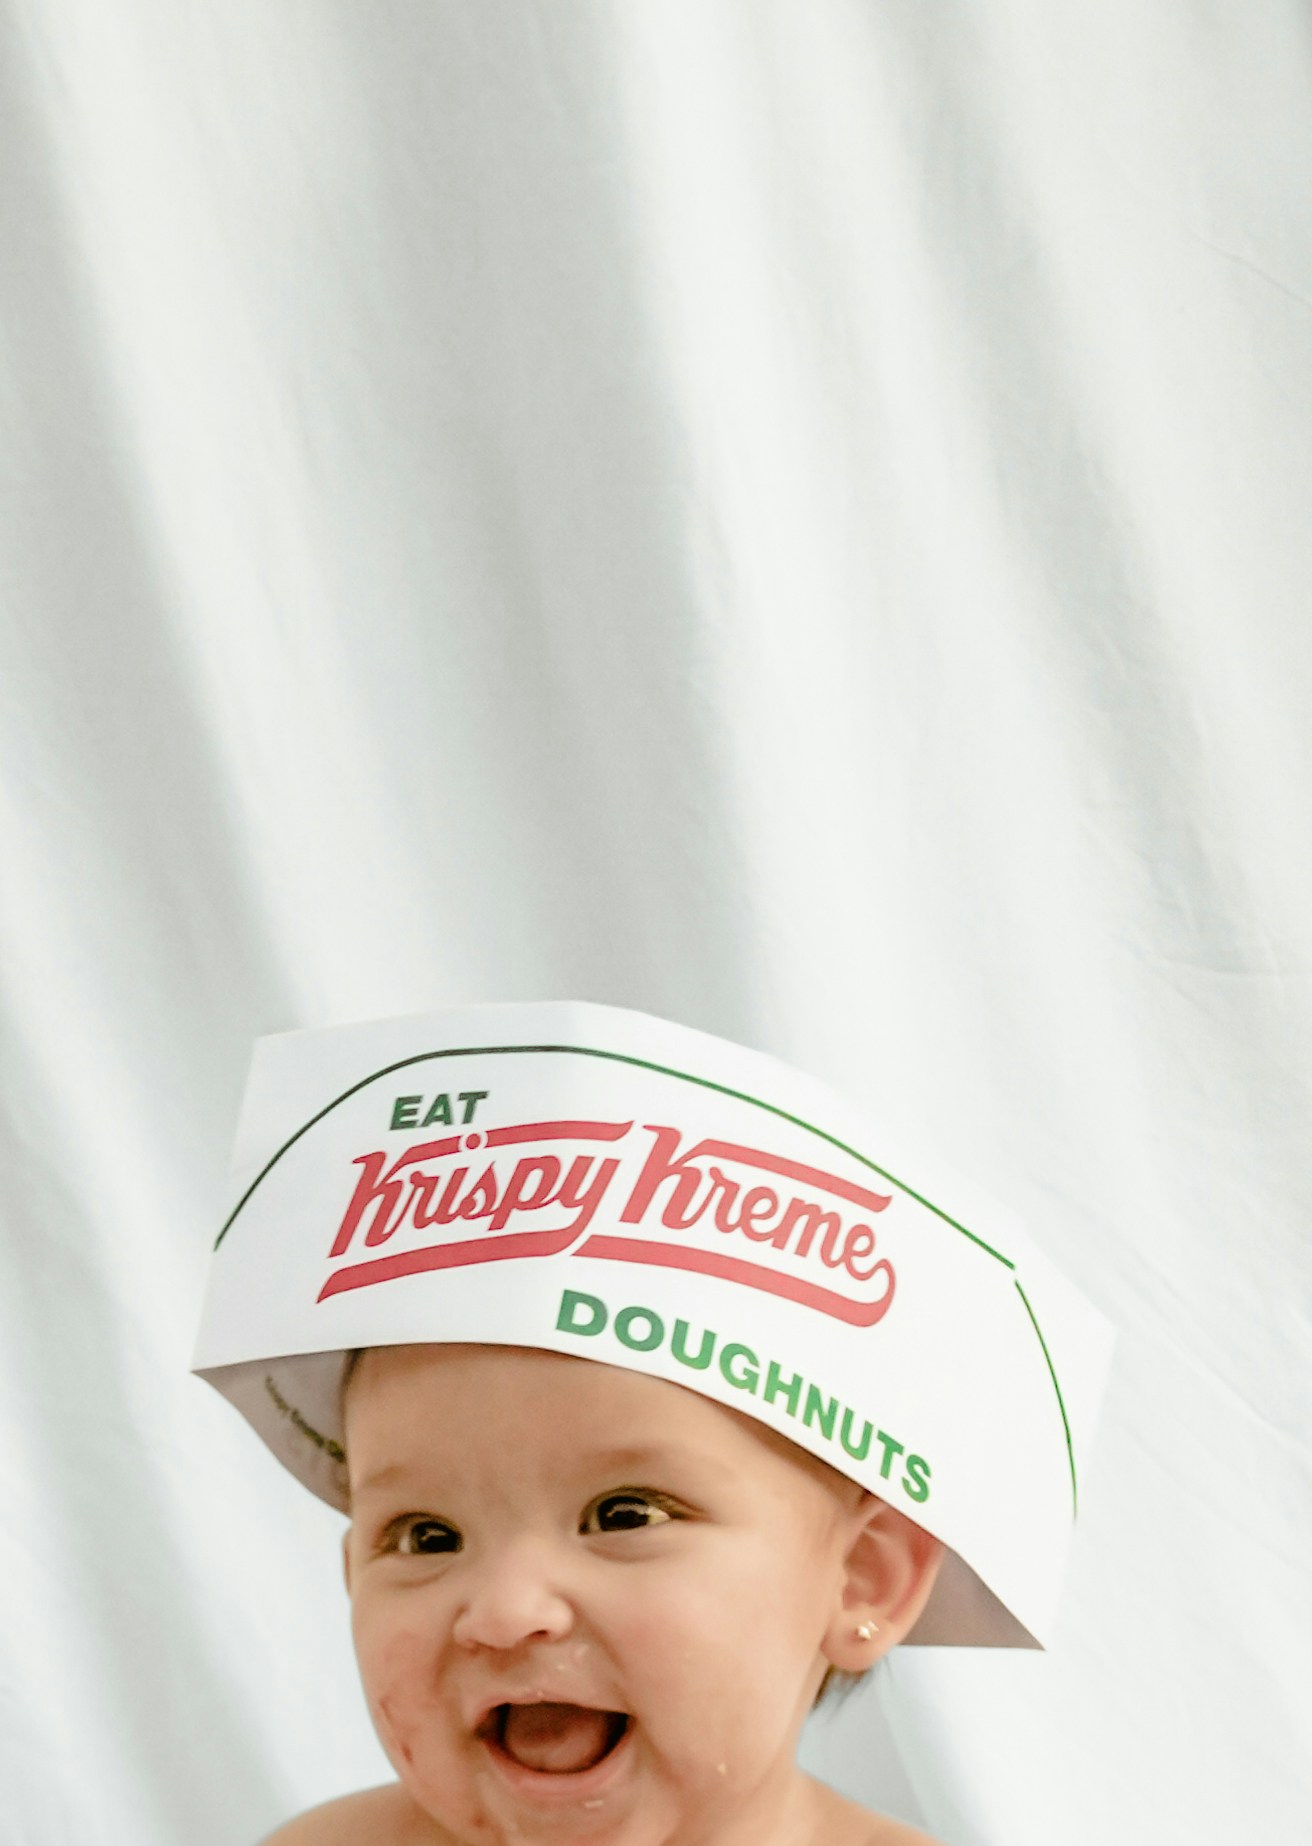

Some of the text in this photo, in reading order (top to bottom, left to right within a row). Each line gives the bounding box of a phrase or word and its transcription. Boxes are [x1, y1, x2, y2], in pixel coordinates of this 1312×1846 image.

[388, 1089, 490, 1132] EAT
[317, 1122, 896, 1328] Krispy Kreme
[554, 1288, 934, 1505] DOUGHNUTS
